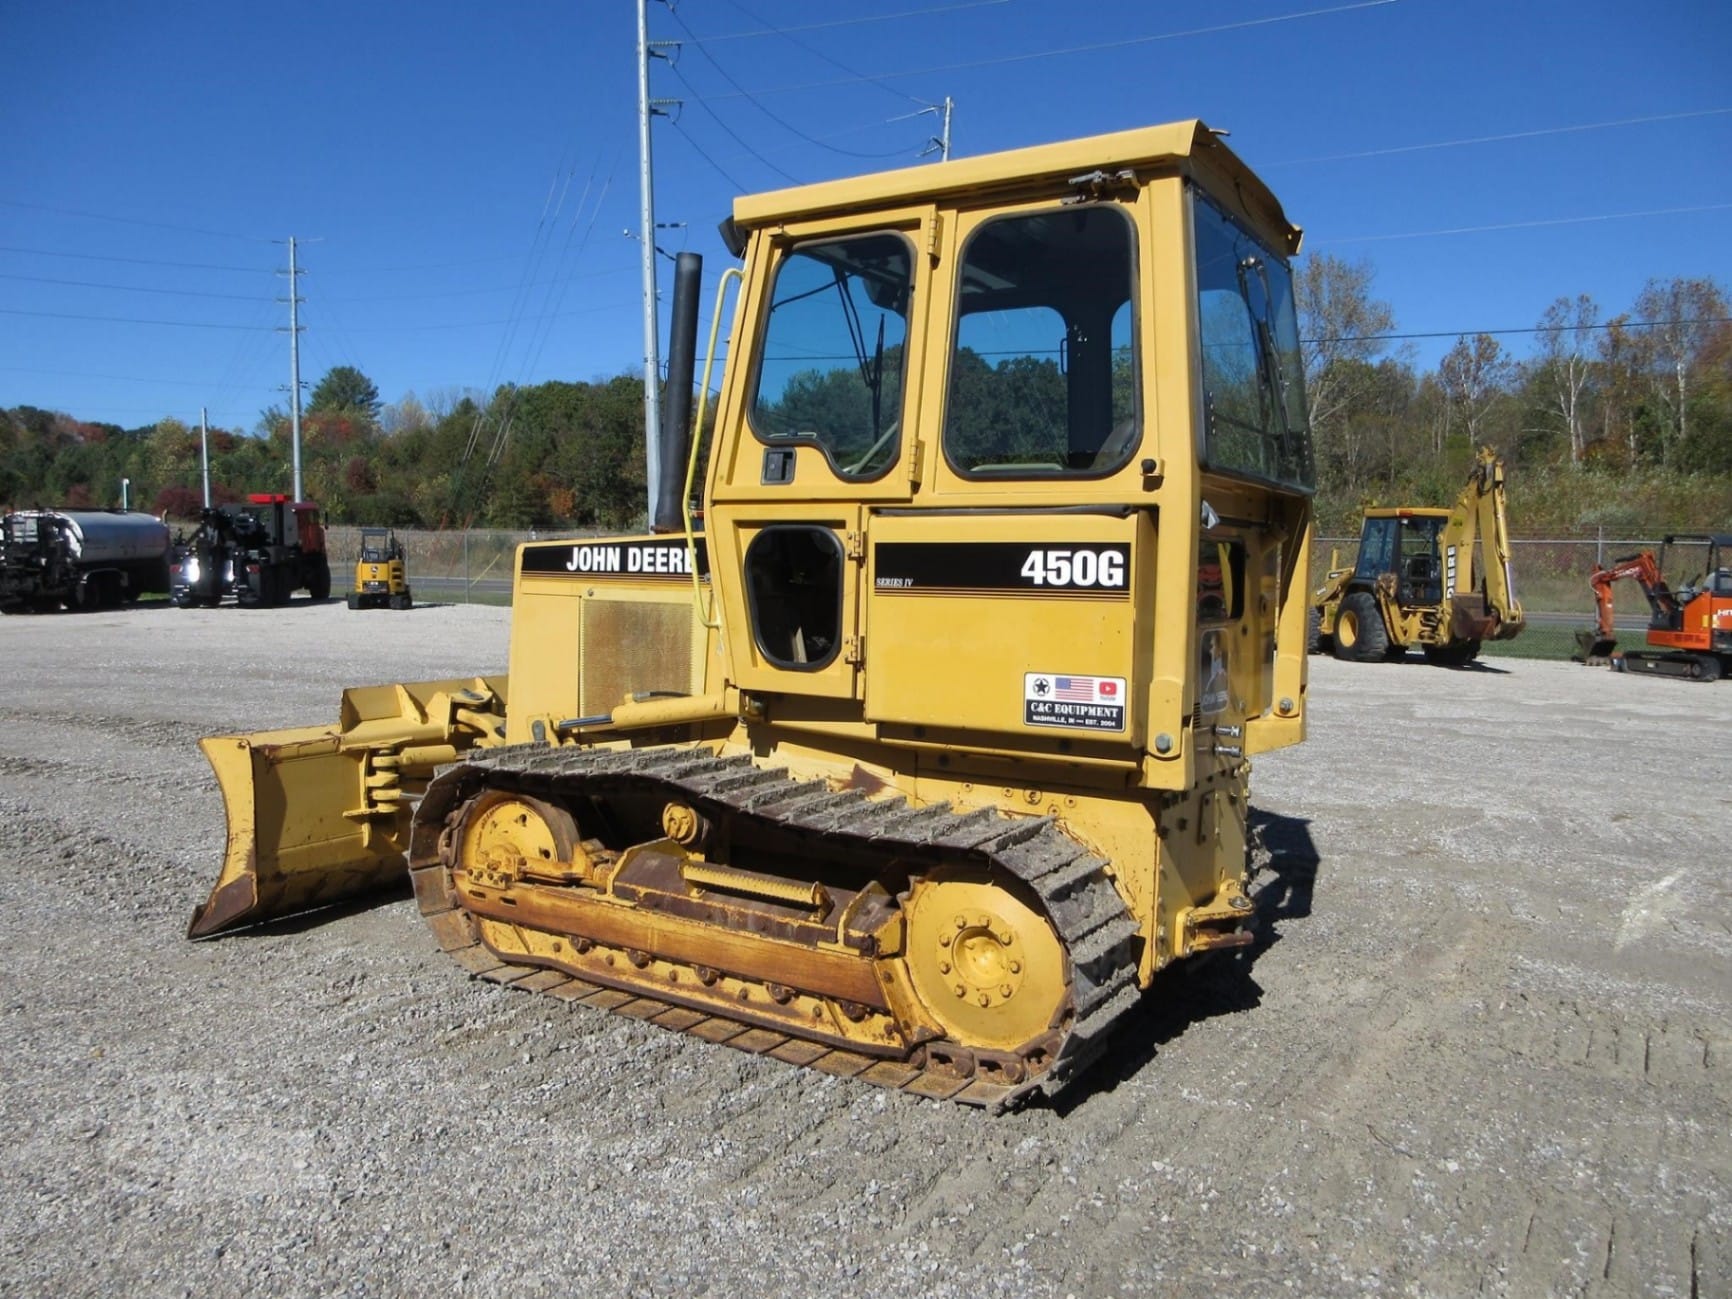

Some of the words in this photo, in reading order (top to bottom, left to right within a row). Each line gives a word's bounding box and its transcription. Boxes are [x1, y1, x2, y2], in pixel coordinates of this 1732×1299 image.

[566, 546, 620, 572] JOHN
[627, 547, 697, 573] DEERE
[1020, 550, 1124, 586] 450G
[1446, 546, 1456, 599] DEERE
[876, 577, 903, 587] SERIES
[904, 578, 914, 588] IV
[1030, 702, 1052, 713] C&C
[1054, 704, 1119, 718] EQUIPMENT
